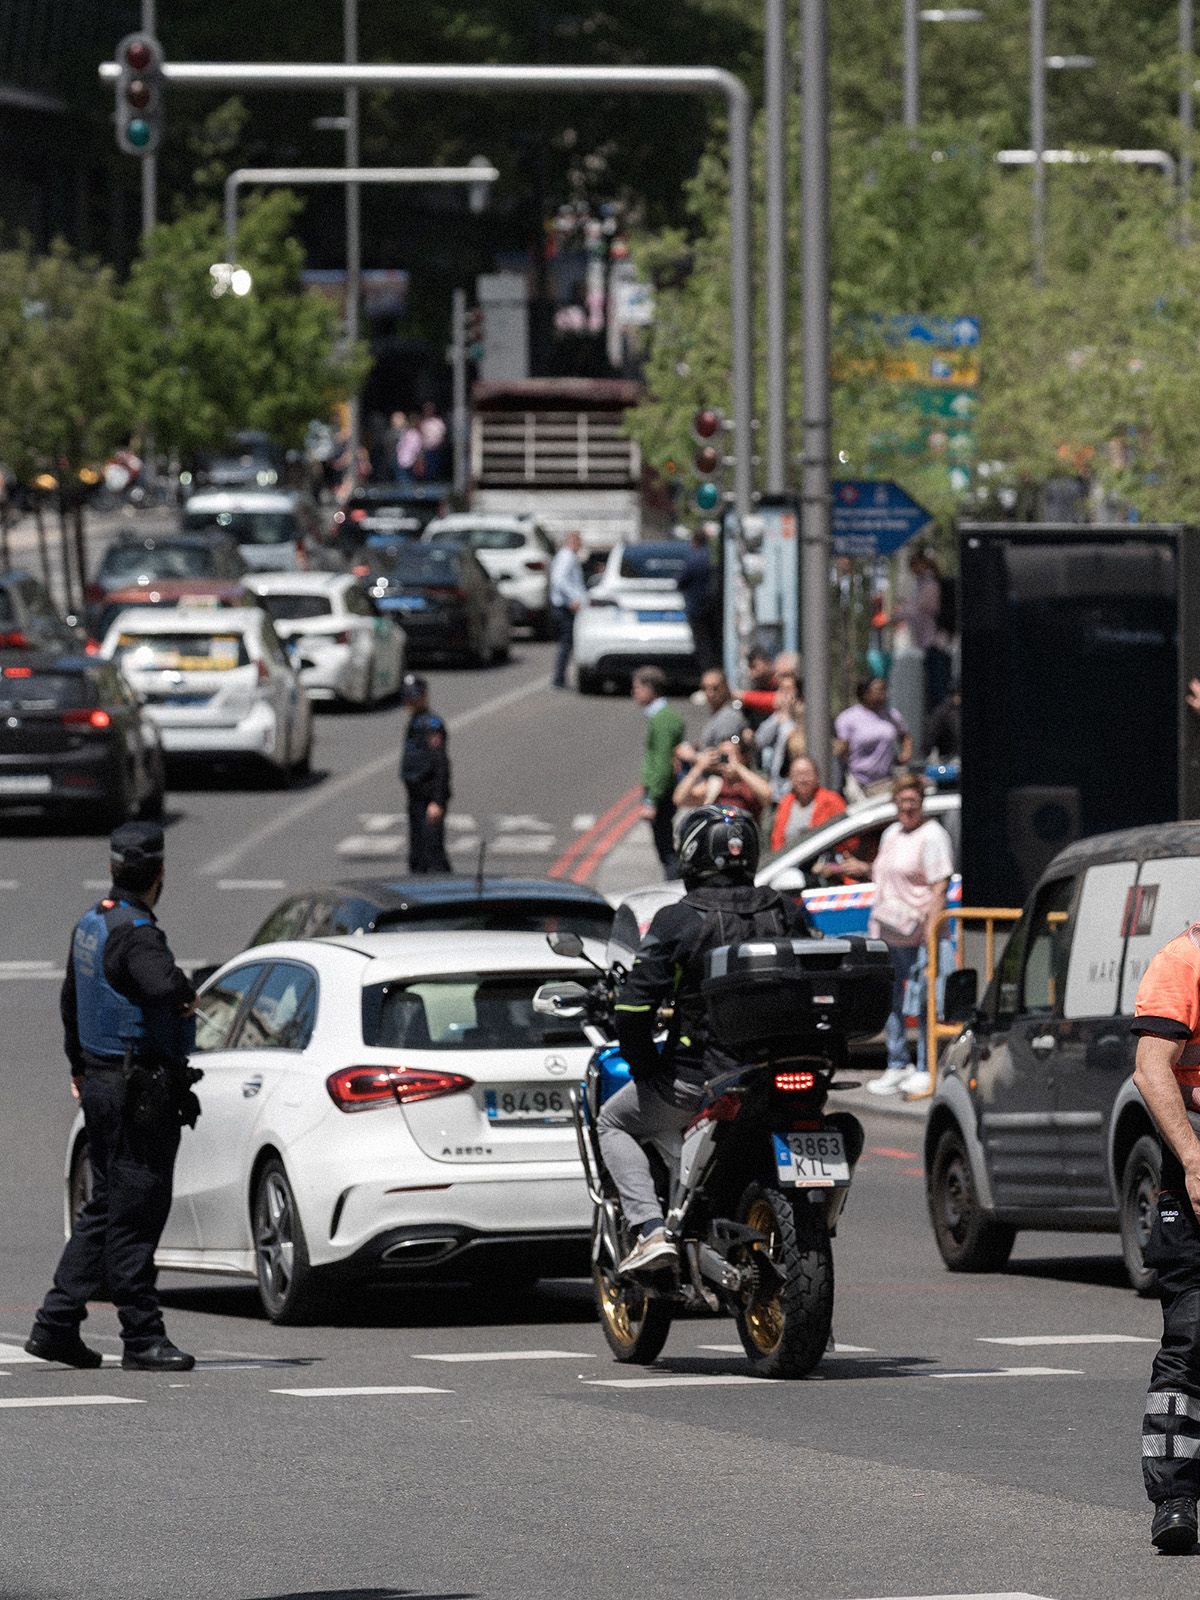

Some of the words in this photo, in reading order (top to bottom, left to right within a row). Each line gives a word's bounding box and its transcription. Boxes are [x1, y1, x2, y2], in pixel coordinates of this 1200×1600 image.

[503, 1091, 562, 1113] 8496
[793, 1137, 840, 1156] 3863
[795, 1158, 831, 1176] KTL
